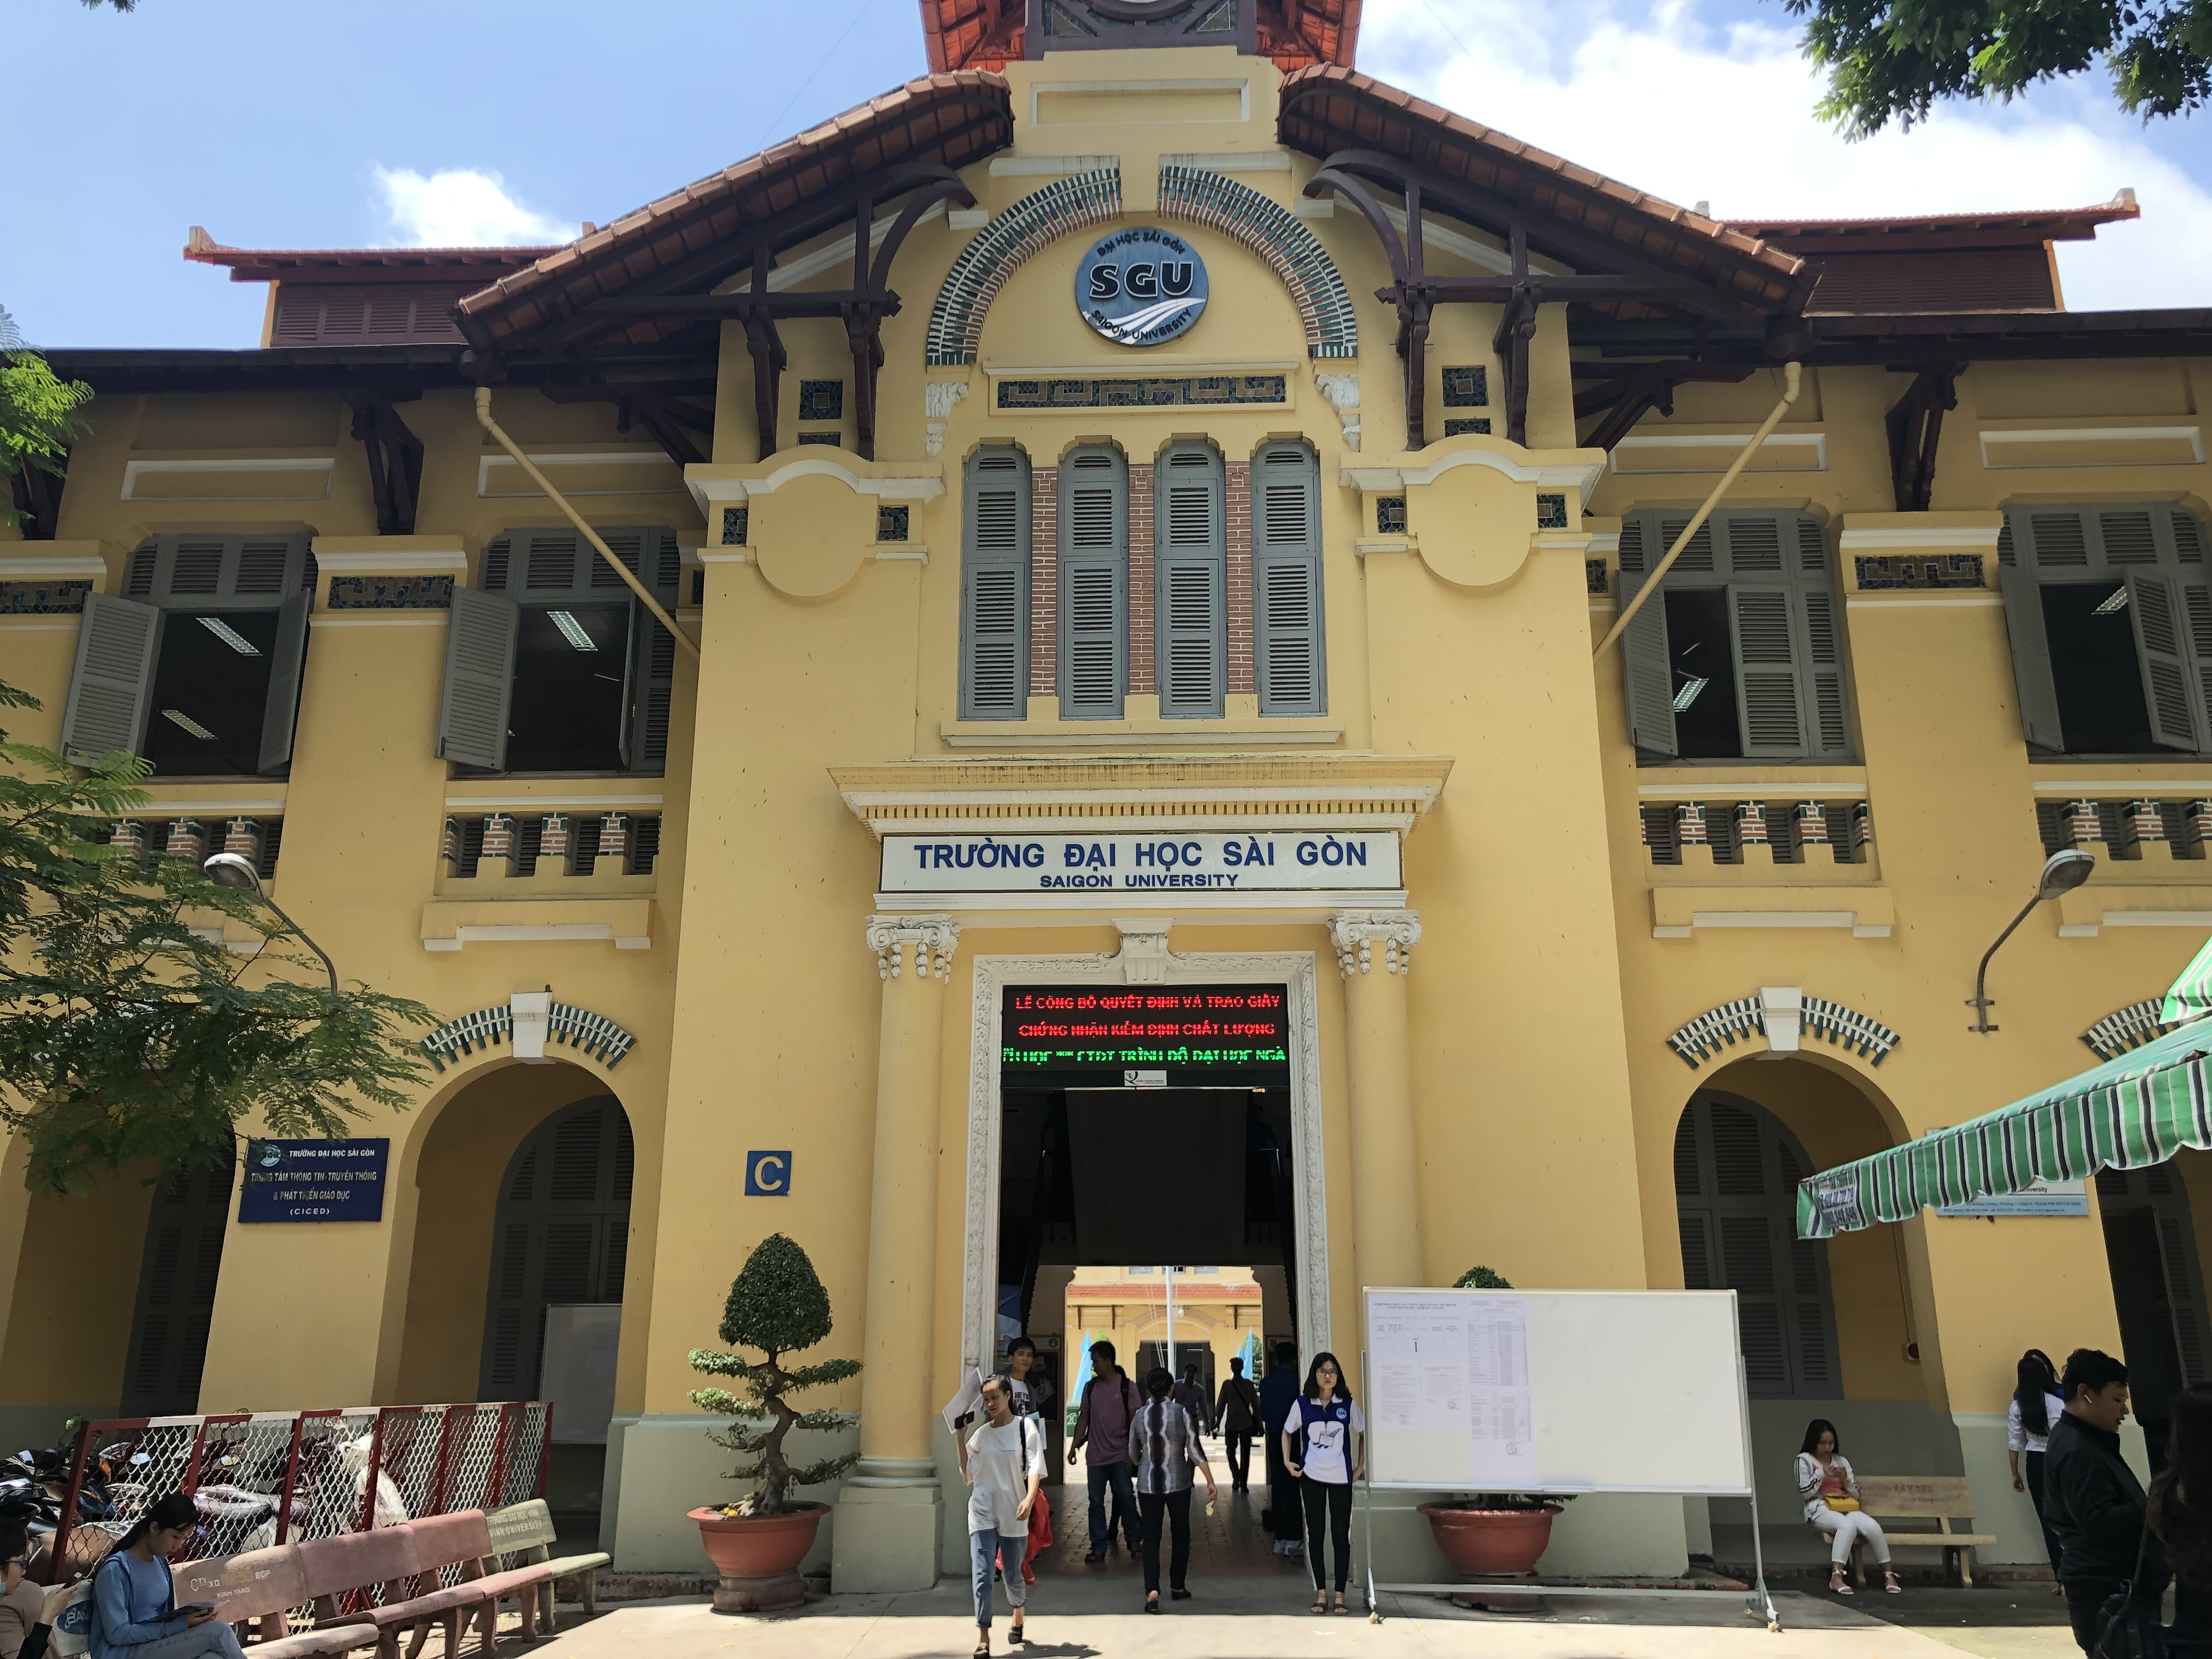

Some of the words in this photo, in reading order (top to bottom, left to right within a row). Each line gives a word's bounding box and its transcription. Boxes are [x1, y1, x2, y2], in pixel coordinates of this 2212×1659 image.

[1089, 261, 1194, 299] SGU
[1091, 310, 1128, 338] SAIGON
[1132, 308, 1192, 340] UNIVERSITY
[914, 837, 1045, 868] TRƯỜNG
[1064, 843, 1116, 872] ĐẠI
[1136, 842, 1203, 872] HỌC
[1223, 836, 1274, 866] SÀI
[1296, 835, 1367, 866] GÒN
[1040, 874, 1113, 888] SAIGON
[1125, 873, 1239, 887] UNIVERSITY
[1036, 995, 1074, 1009] CÔNG
[1099, 993, 1144, 1009] QUYẾT
[1146, 996, 1179, 1009] ĐỊNH
[1182, 994, 1203, 1008] VÀ
[1206, 996, 1244, 1008] TRAO
[1018, 1020, 1068, 1036] CHỨNG
[1182, 1019, 1220, 1035] CHẤT
[1223, 1023, 1275, 1037] LƯỢNG
[289, 1148, 317, 1158] TRƯỜNG
[331, 1150, 346, 1159] HỌC
[347, 1148, 359, 1156] SÀI
[360, 1148, 375, 1156] GÒN
[355, 1169, 377, 1181] THÔNG
[755, 1156, 783, 1190] C
[319, 1188, 335, 1200] GIÁO
[336, 1190, 350, 1202] DỤC
[505, 1520, 543, 1536] UNIVERSITY
